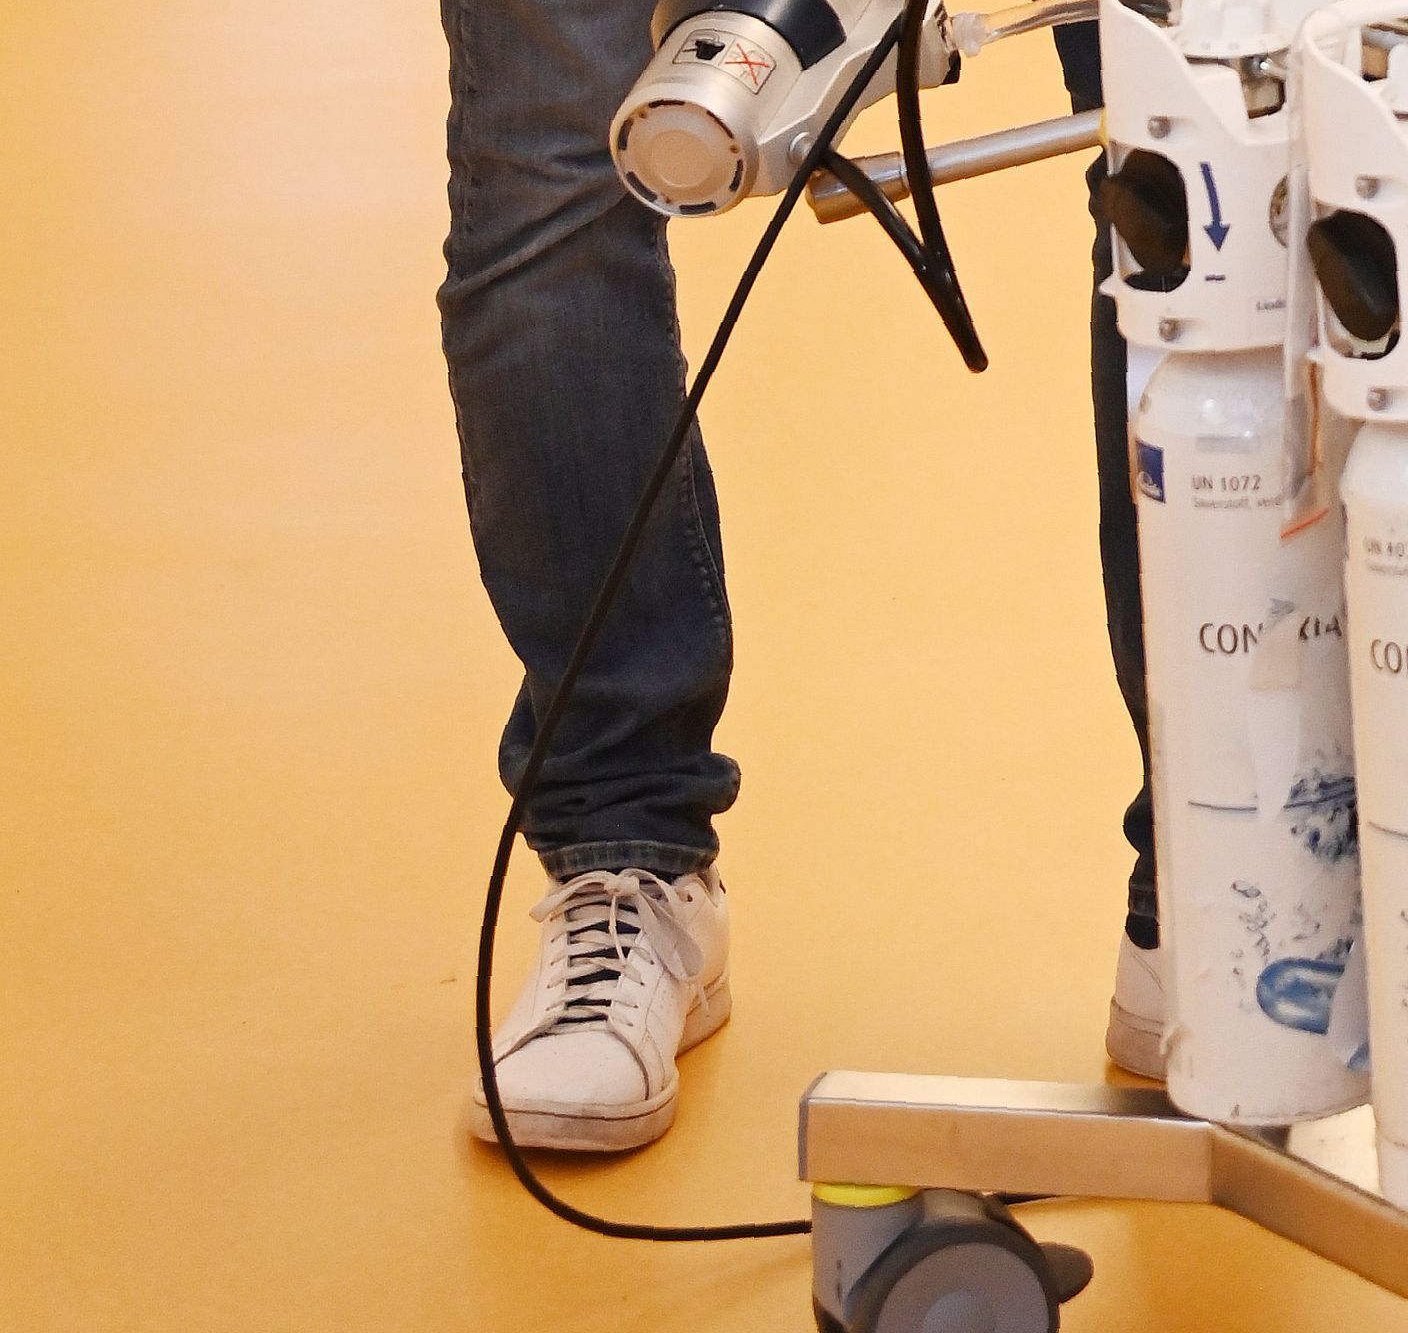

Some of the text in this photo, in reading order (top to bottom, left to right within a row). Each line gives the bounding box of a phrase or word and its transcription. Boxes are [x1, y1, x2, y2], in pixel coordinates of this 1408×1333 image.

[1192, 474, 1262, 492] UN 1072
[1199, 616, 1343, 655] CONXIA
